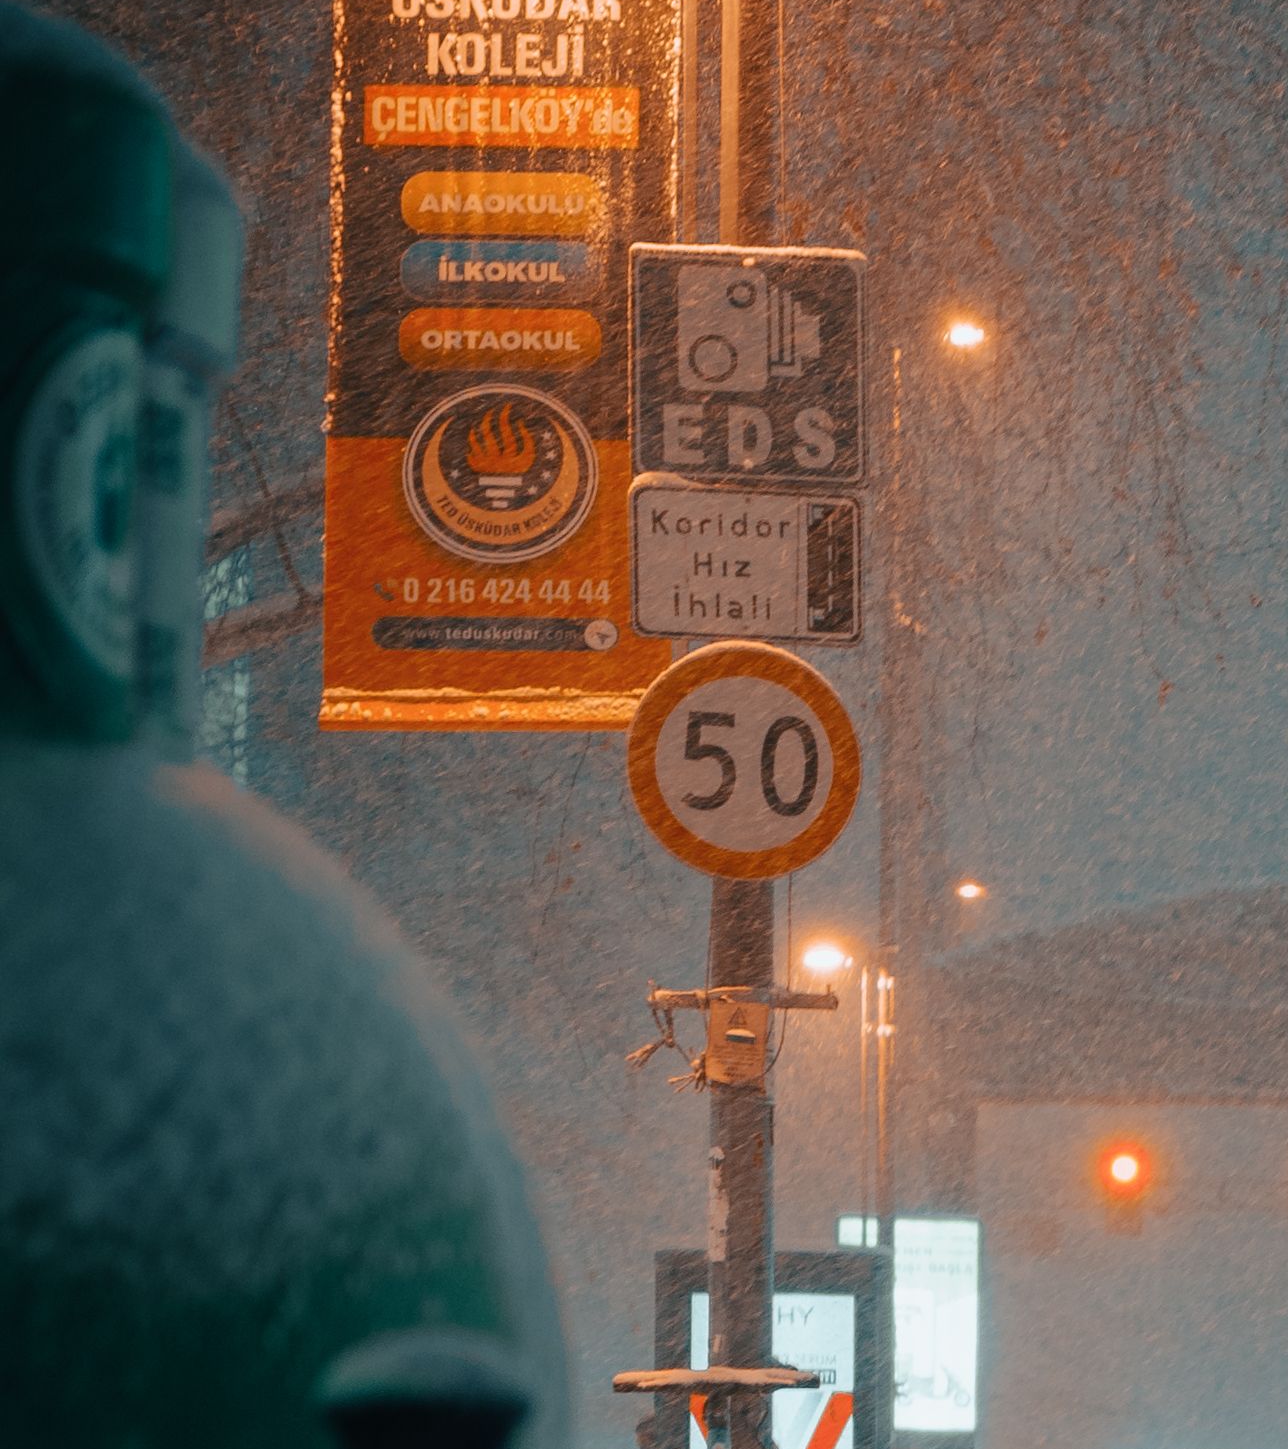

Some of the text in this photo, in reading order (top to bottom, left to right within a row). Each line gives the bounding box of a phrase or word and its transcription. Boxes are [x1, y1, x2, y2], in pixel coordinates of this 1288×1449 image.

[427, 24, 585, 78] KOLEJİ
[418, 191, 585, 215] ANAOKULU
[438, 255, 565, 283] İLKOKUL
[420, 329, 580, 352] ORTAOKUL
[663, 403, 836, 468] EDS
[435, 494, 457, 519] TED
[457, 514, 521, 537] ÜSKÜDAR
[651, 509, 792, 538] Koridor
[693, 552, 752, 578] Hız
[403, 578, 611, 604] 0 216 424 44 44
[673, 585, 772, 620] İhlali
[681, 711, 820, 817] 50
